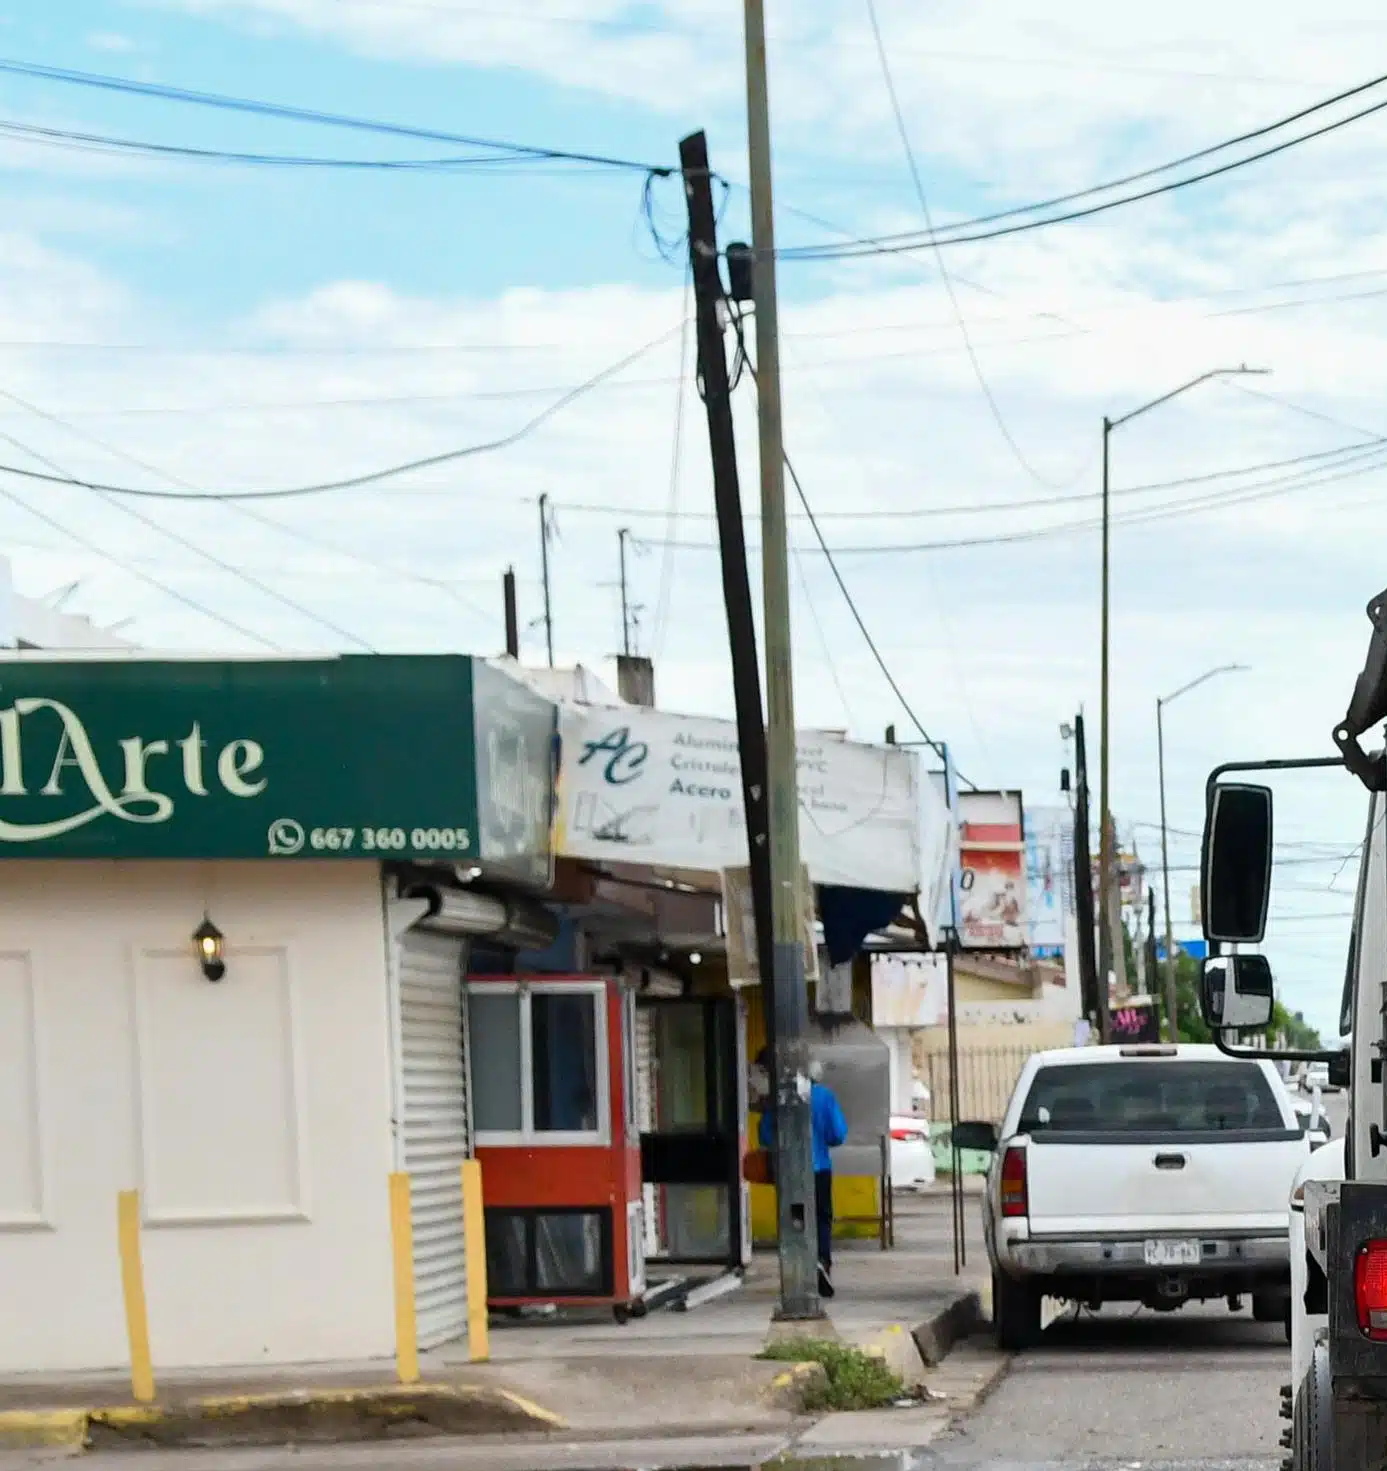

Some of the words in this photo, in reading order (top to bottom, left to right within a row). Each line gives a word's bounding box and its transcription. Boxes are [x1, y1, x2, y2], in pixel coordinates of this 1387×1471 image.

[669, 777, 731, 800] Acero
[310, 828, 354, 850] 667
[361, 828, 406, 850] 360
[411, 828, 470, 850] 0005
